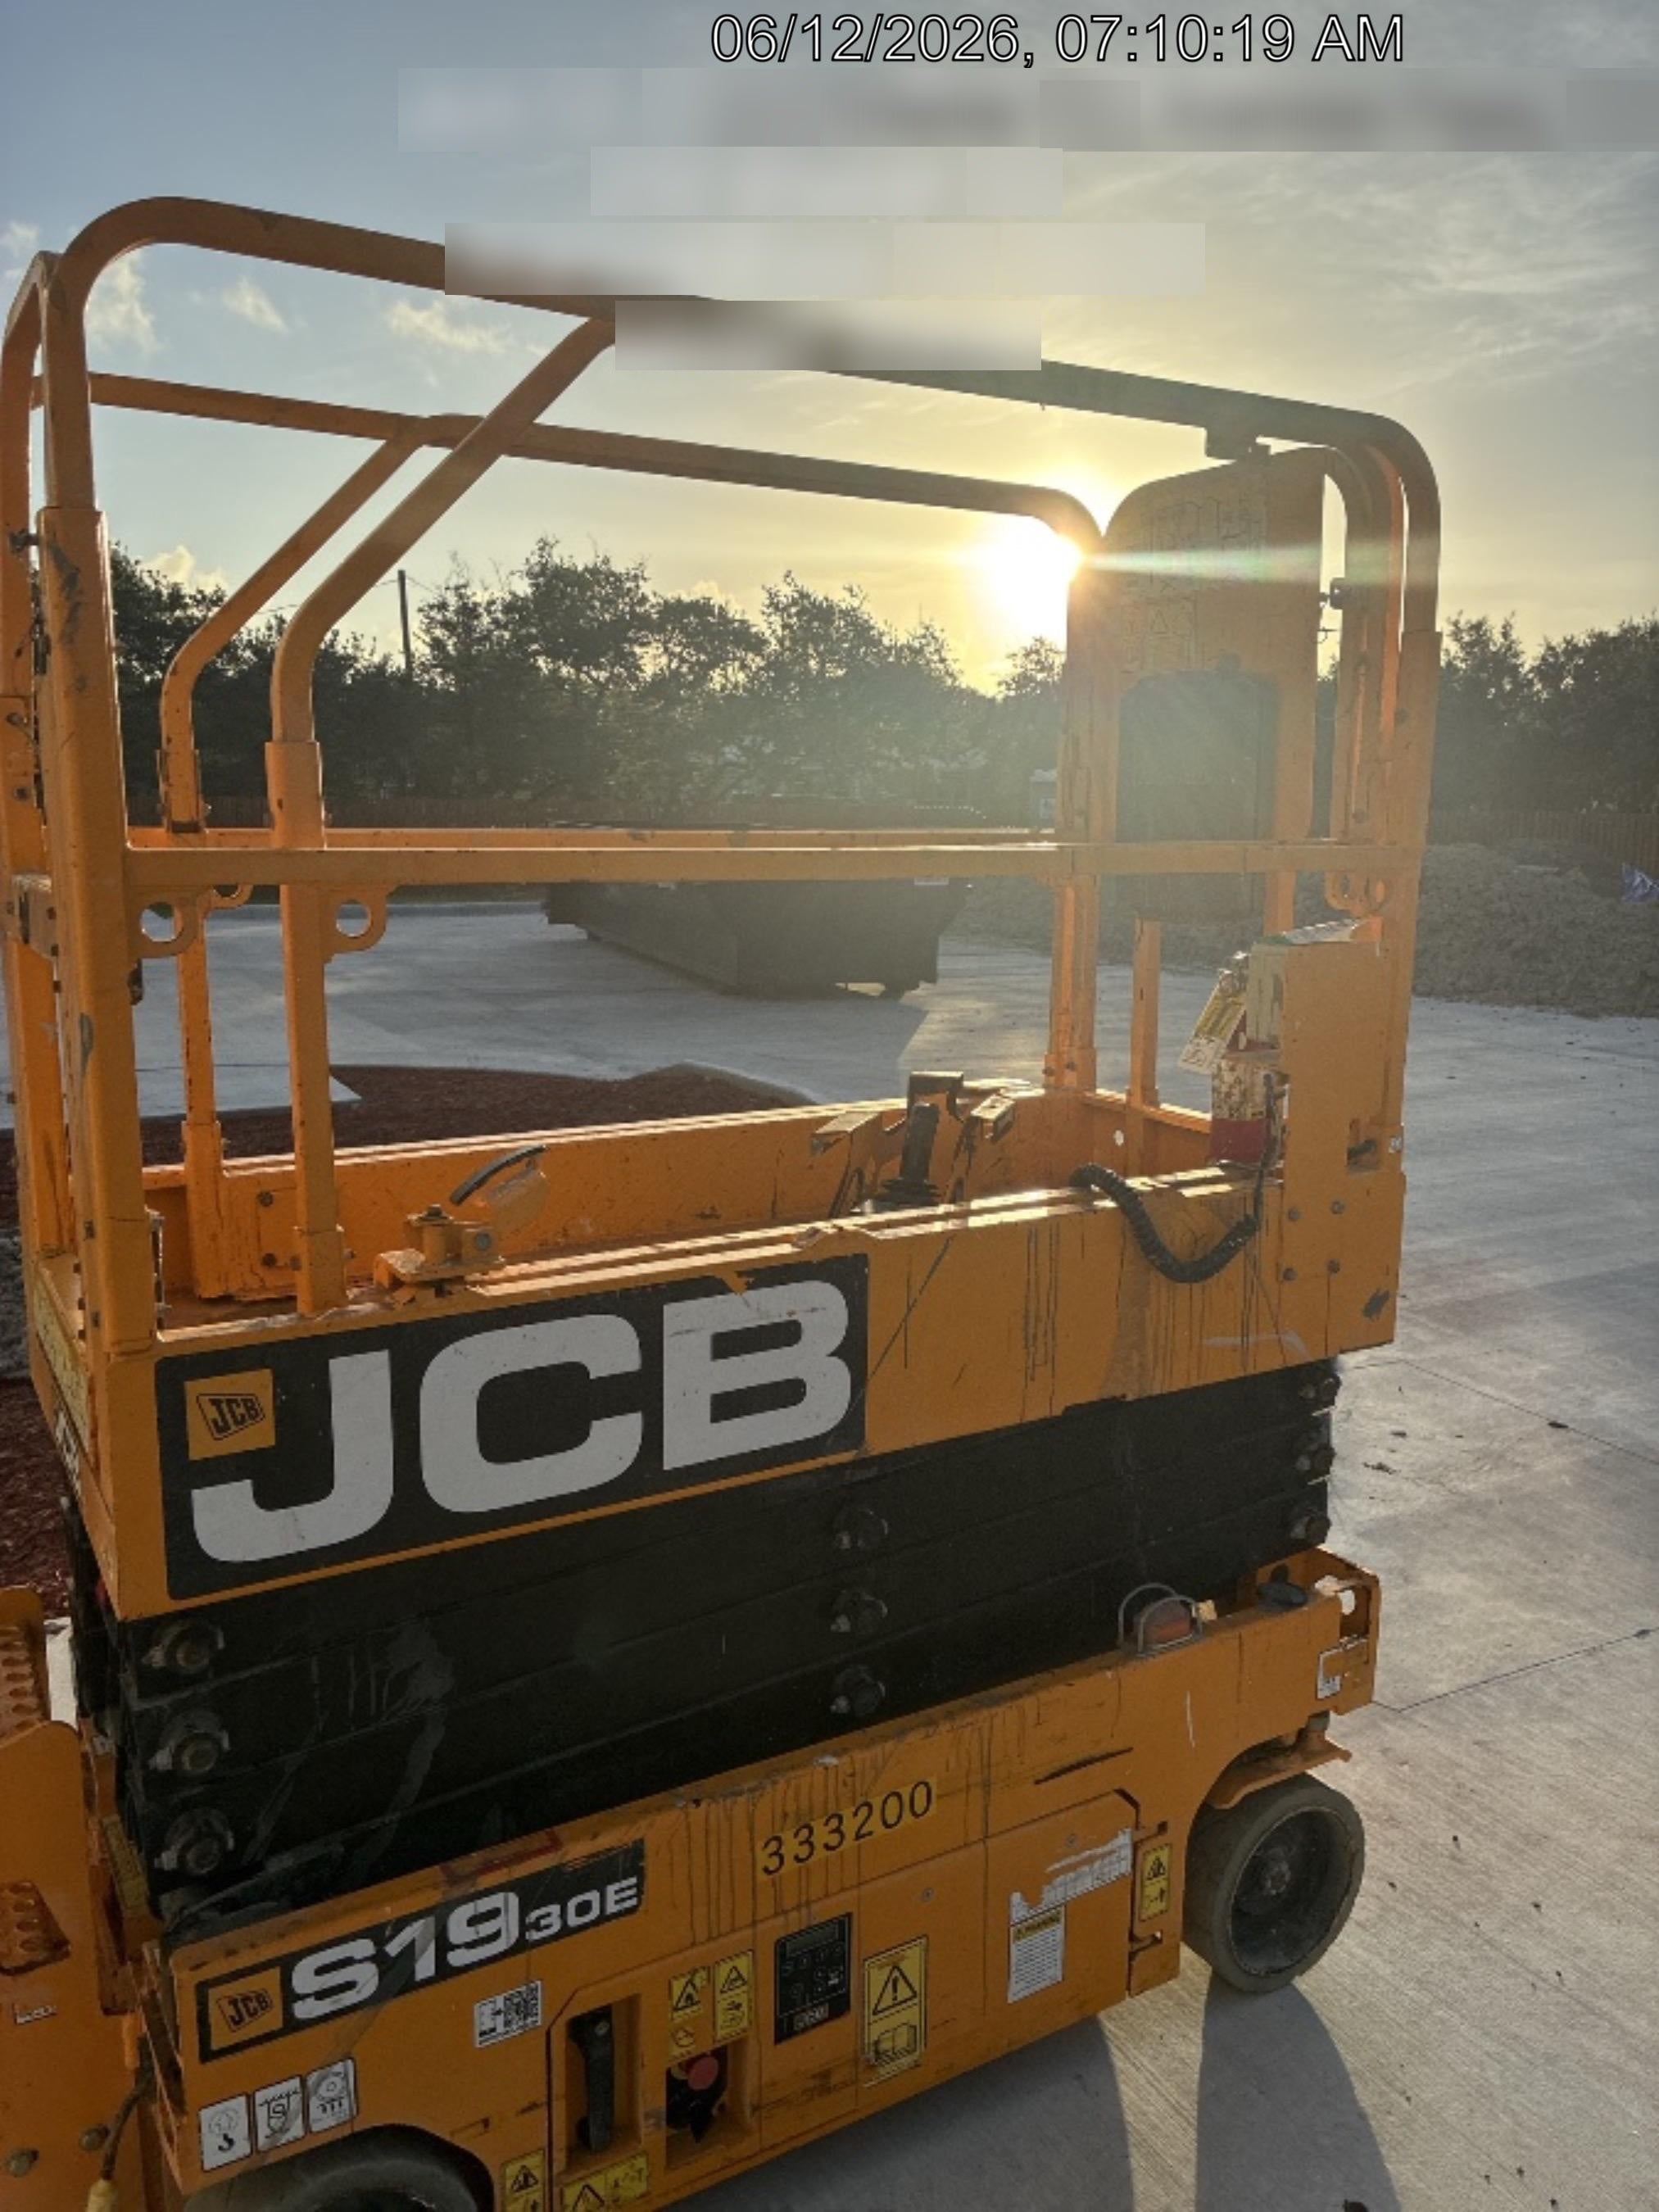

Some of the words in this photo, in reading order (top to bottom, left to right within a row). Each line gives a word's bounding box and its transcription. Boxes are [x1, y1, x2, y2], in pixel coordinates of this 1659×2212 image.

[192, 1280, 851, 1562] JCB
[206, 1396, 261, 1436] JCB
[762, 1780, 932, 1875] 333200
[227, 1991, 270, 2027] JCB
